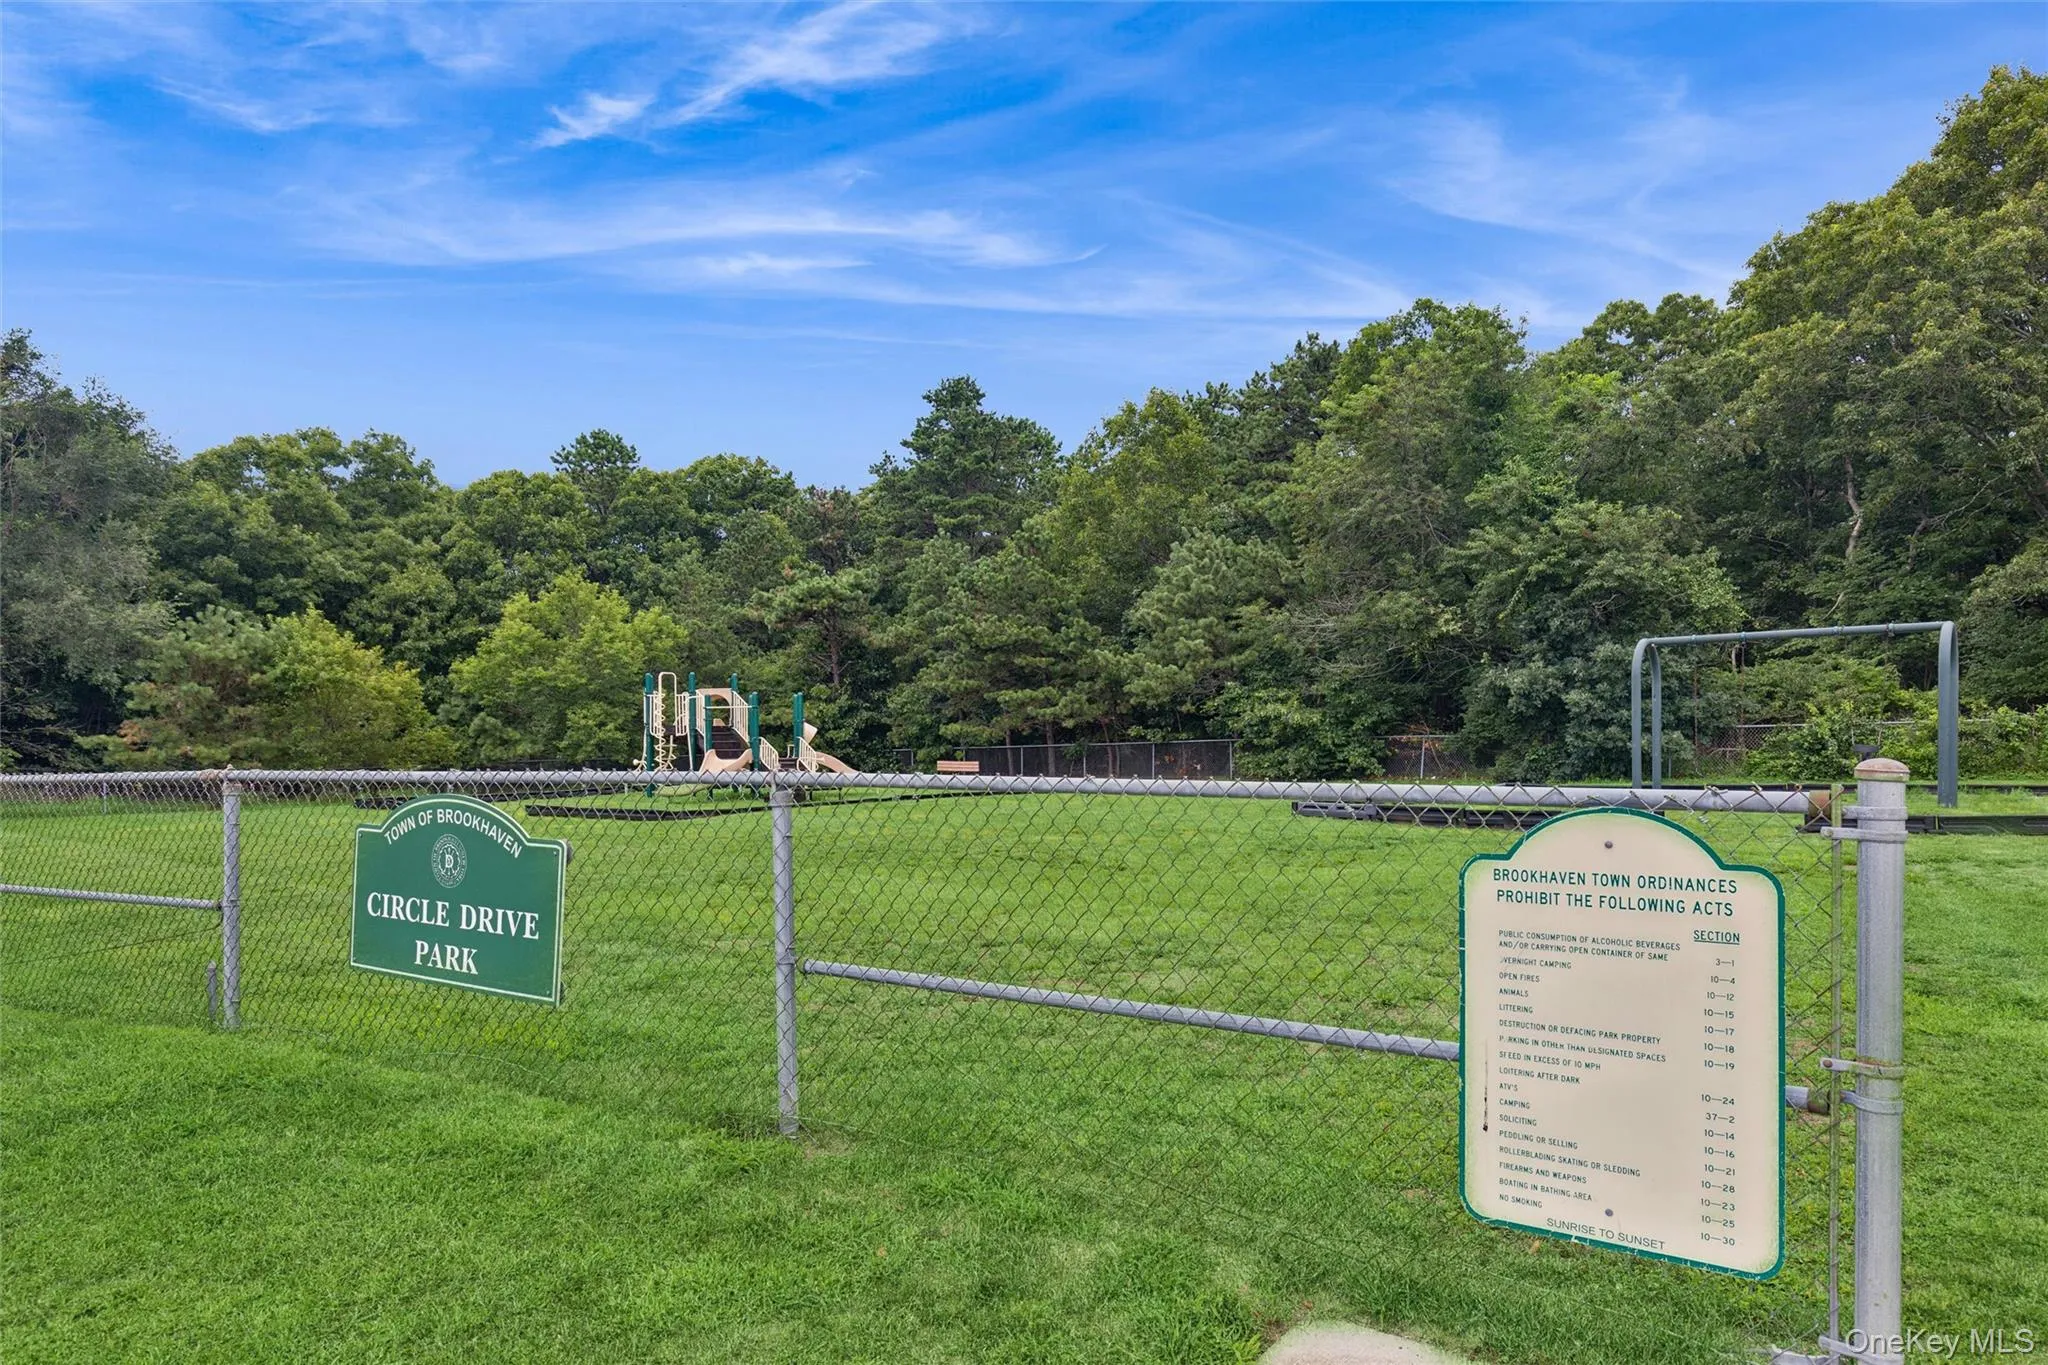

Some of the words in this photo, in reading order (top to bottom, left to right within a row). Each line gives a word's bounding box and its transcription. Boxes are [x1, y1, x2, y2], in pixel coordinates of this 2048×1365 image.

[384, 816, 416, 845] TOWN
[418, 810, 433, 826] OF
[437, 809, 522, 858] BROOKHAVEN
[1493, 868, 1586, 886] BROOKHAVEN
[1592, 873, 1630, 888] TOWN
[1637, 875, 1737, 894] ORDINANCES
[1496, 890, 1561, 905] PROHIBIT
[1566, 893, 1593, 907] THE
[1599, 896, 1686, 914] FOLLOWING
[1692, 901, 1734, 917] ACTS
[367, 892, 449, 927] CIRCLE
[459, 904, 539, 940] DRIVE
[1499, 930, 1524, 938] PUBLIC
[1526, 932, 1577, 942] CONSUMPTION
[1591, 938, 1633, 947] ALCOHOLIC
[1635, 940, 1681, 951] BEVERAGES
[1693, 930, 1740, 942] SECTION
[414, 940, 478, 975] PARK
[1499, 941, 1529, 949] AND/OR
[1531, 943, 1566, 952] CARRYING
[1569, 946, 1588, 954] OPEN
[1591, 948, 1632, 958] CONTAINER
[1648, 953, 1668, 961] SAME
[1499, 956, 1537, 966] VERNIGHT
[1539, 960, 1572, 969] CAMPING
[1499, 972, 1518, 980] OPEN
[1520, 974, 1540, 982] FIRES
[1499, 988, 1529, 998] ANIMALS
[1499, 1004, 1533, 1013] LITTERING
[1499, 1019, 1546, 1031] DESTRUCTION
[1560, 1027, 1596, 1037] DEFACING
[1599, 1031, 1618, 1039] PARK
[1622, 1034, 1661, 1045] PROPERTY
[1499, 1035, 1529, 1045] PRKING
[1636, 1053, 1666, 1062] SPACES
[1534, 1056, 1560, 1065] EXCESS
[1585, 1062, 1601, 1070] MPH
[1499, 1067, 1534, 1078] LOITERING
[1537, 1072, 1558, 1081] AFTER
[1561, 1075, 1580, 1084] DARK
[1499, 1098, 1530, 1109] CAMPING
[1499, 1114, 1537, 1127] SOLICITING
[1499, 1130, 1533, 1142] PEDDLING
[1536, 1136, 1546, 1144] OR
[1548, 1138, 1578, 1149] SELLING
[1499, 1146, 1556, 1162] ROLLERBLADING
[1558, 1156, 1588, 1168] SKATING
[1591, 1162, 1601, 1170] OR
[1603, 1164, 1641, 1177] SLEDDING
[1499, 1162, 1533, 1174] FIREARMS
[1535, 1168, 1550, 1178] AND
[1552, 1171, 1587, 1183] WEAPONS
[1499, 1178, 1528, 1189] BOATING
[1541, 1186, 1571, 1198] BATHING
[1573, 1192, 1592, 1201] AREA
[1499, 1194, 1509, 1202] NO
[1511, 1196, 1543, 1208] SMOKING
[1547, 1218, 1596, 1236] SUNRISE
[1599, 1228, 1615, 1239] TO
[1618, 1232, 1666, 1250] SUNSET
